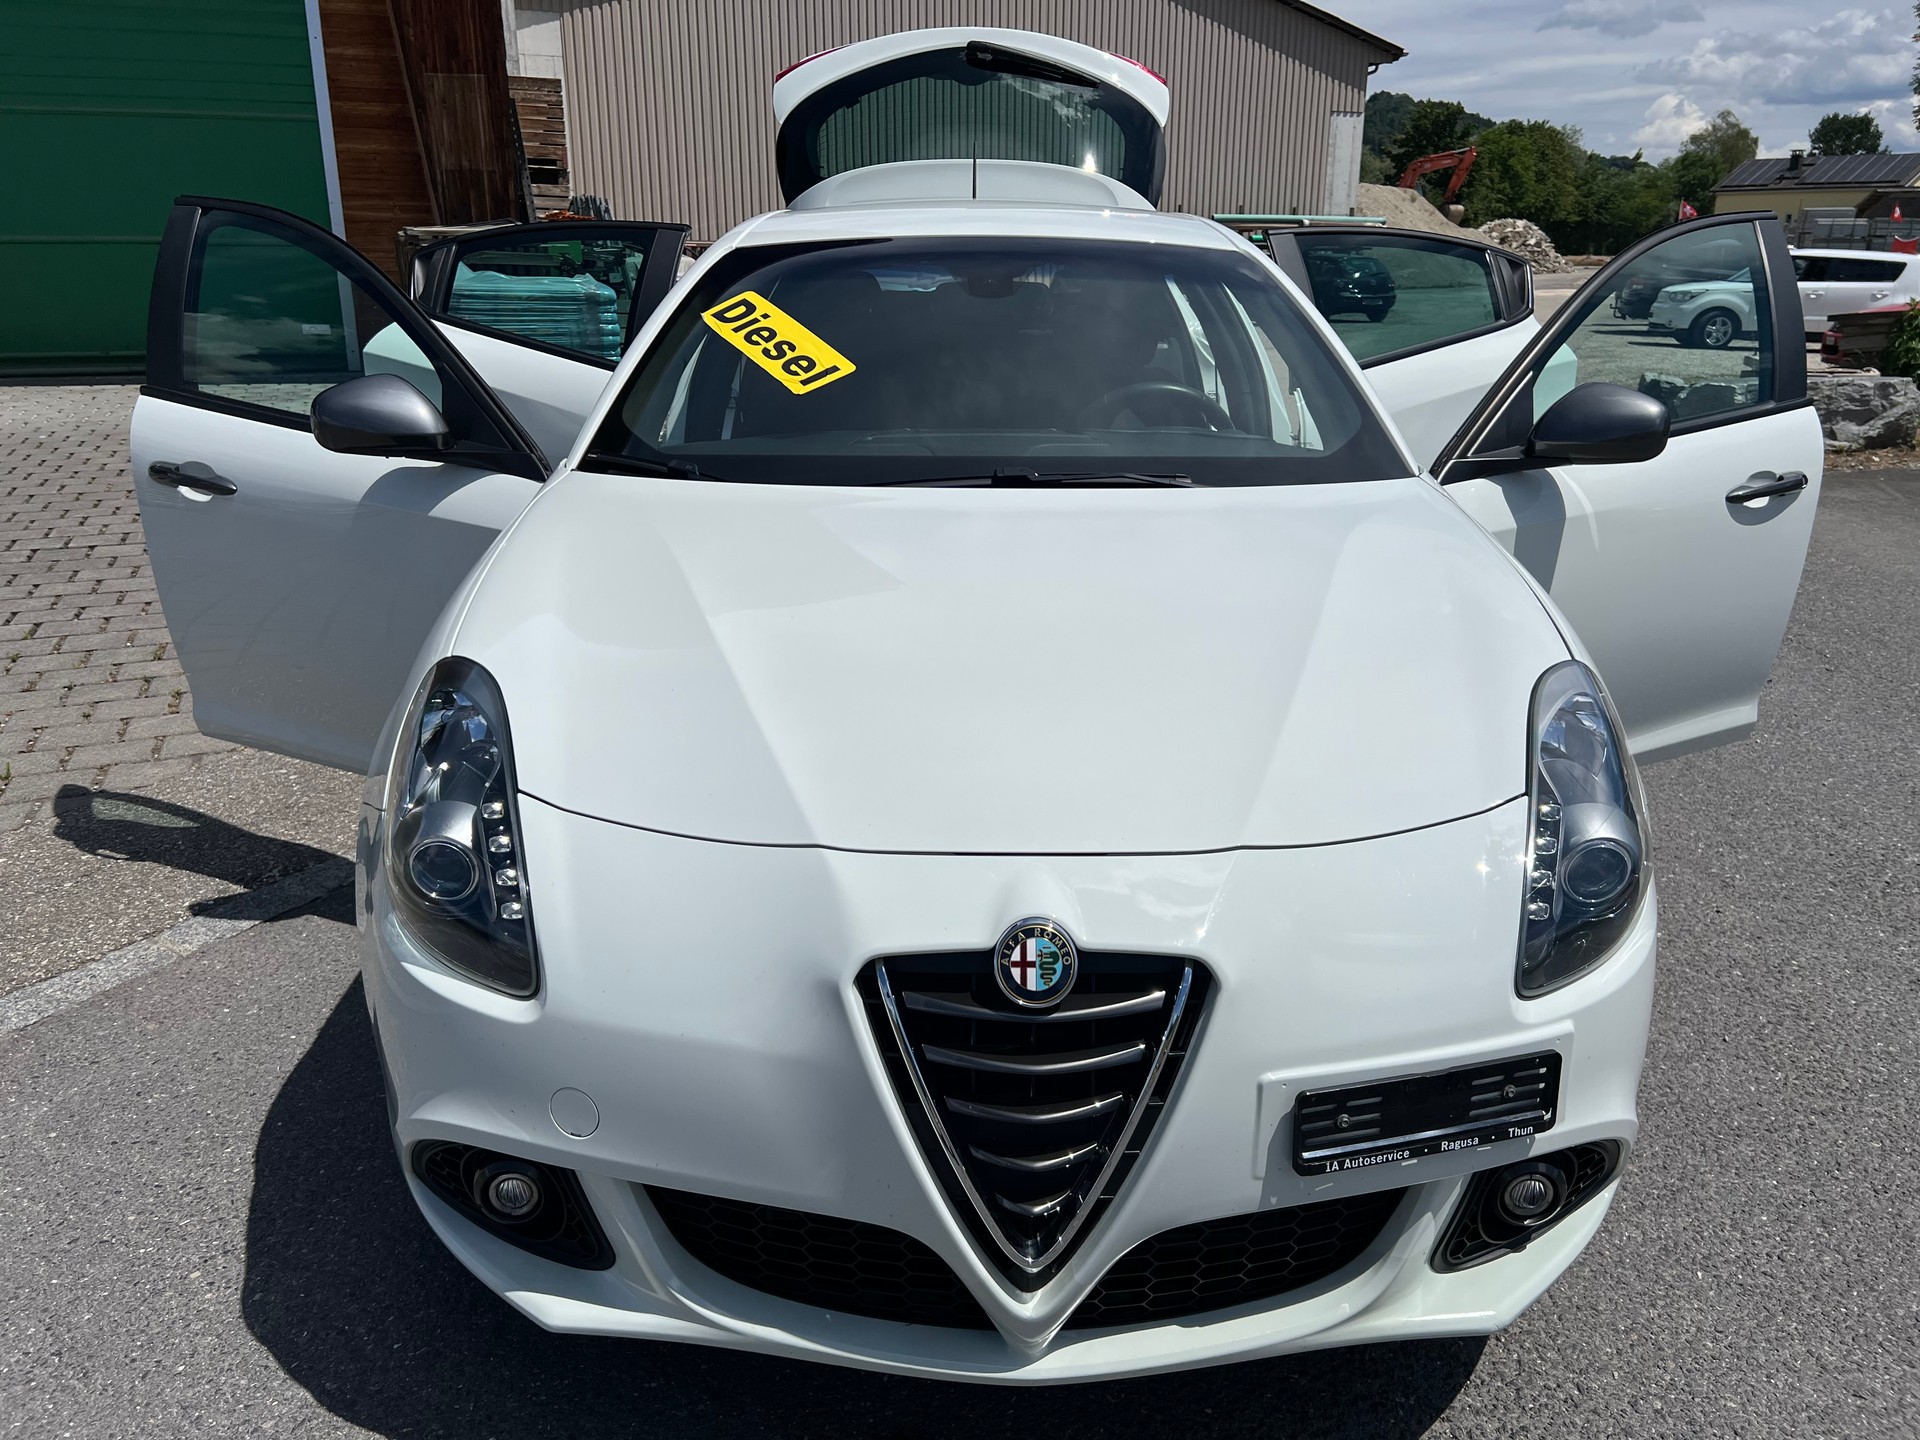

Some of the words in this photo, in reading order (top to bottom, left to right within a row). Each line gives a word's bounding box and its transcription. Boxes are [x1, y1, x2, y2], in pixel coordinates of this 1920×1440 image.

[710, 298, 841, 387] Diesel
[1000, 931, 1027, 967] ALFA
[1034, 927, 1072, 966] ROMEO
[1343, 1150, 1410, 1170] Autoservice
[1441, 1136, 1479, 1151] Ragusa
[1508, 1126, 1534, 1138] Thun
